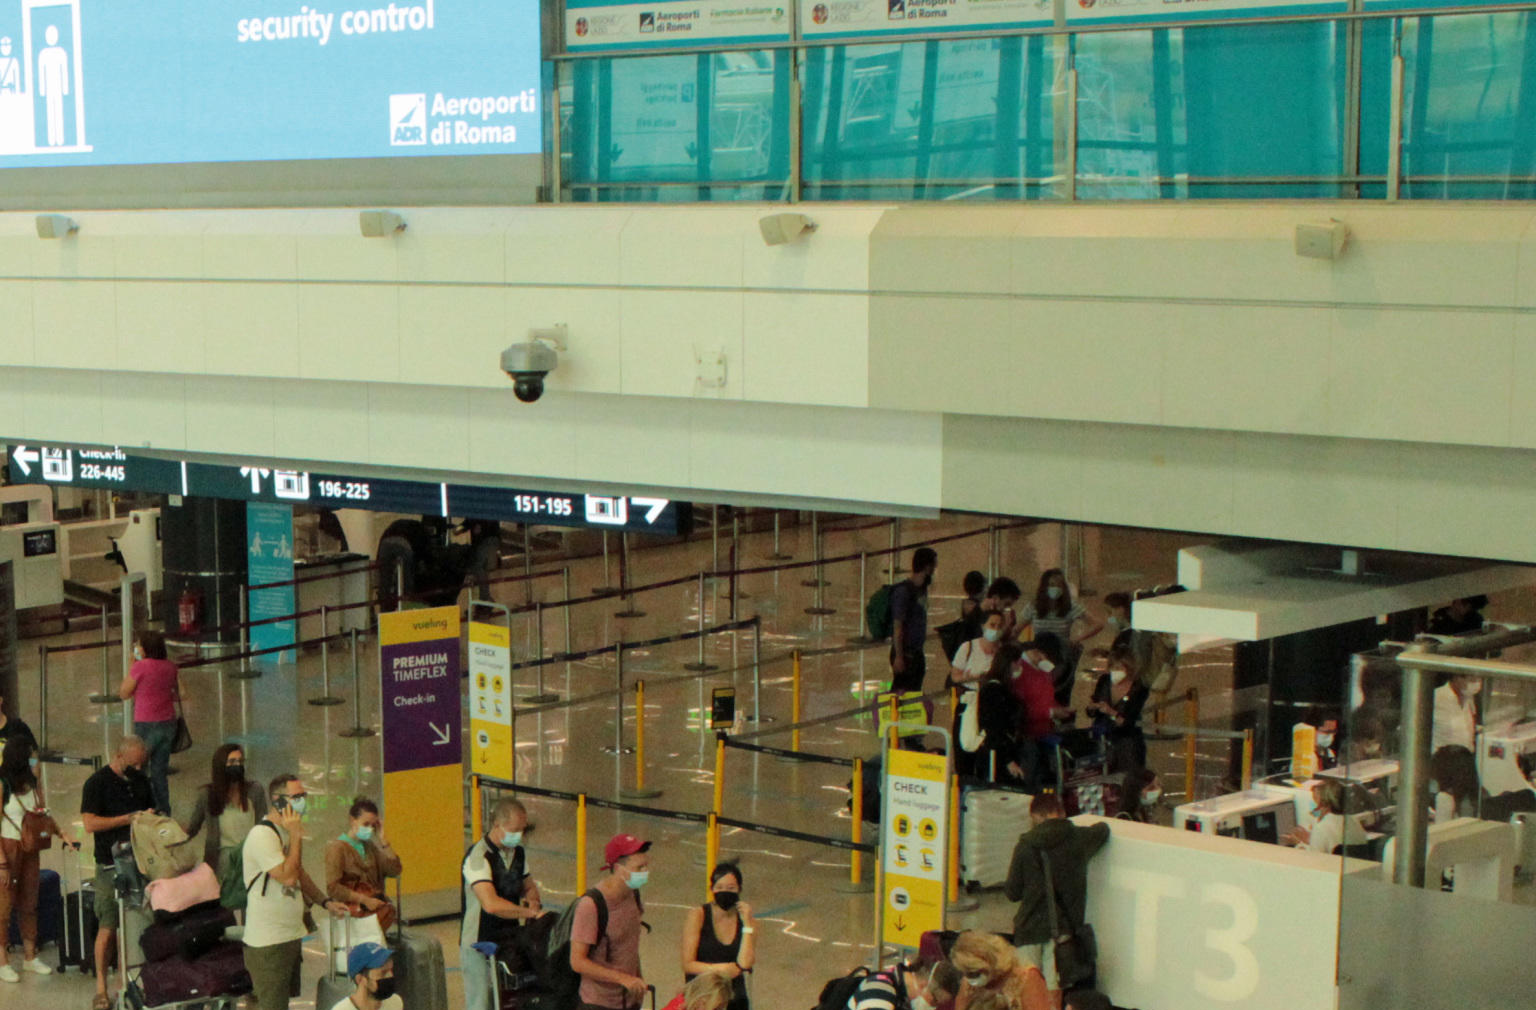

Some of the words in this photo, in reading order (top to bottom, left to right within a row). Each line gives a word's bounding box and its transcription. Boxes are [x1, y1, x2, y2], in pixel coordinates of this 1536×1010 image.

[656, 10, 700, 22] Aeroporti
[919, 9, 947, 18] Roma
[237, 6, 333, 45] security
[340, 0, 434, 35] control
[656, 23, 665, 32] di
[667, 22, 692, 32] Roma
[431, 88, 536, 120] Aeroporti
[394, 125, 422, 142] ADR
[431, 121, 450, 145] di
[454, 120, 516, 144] Roma
[80, 464, 126, 482] 226-445
[318, 479, 370, 500] 196-225
[514, 494, 572, 516] 151-195
[412, 618, 448, 631] vueling
[393, 652, 449, 669] PREMIUM
[474, 647, 496, 658] CHECK
[393, 665, 448, 682] TIMEFLEX
[393, 693, 436, 708] Check-in
[894, 781, 928, 795] CHECK
[1107, 862, 1260, 1003] T3
